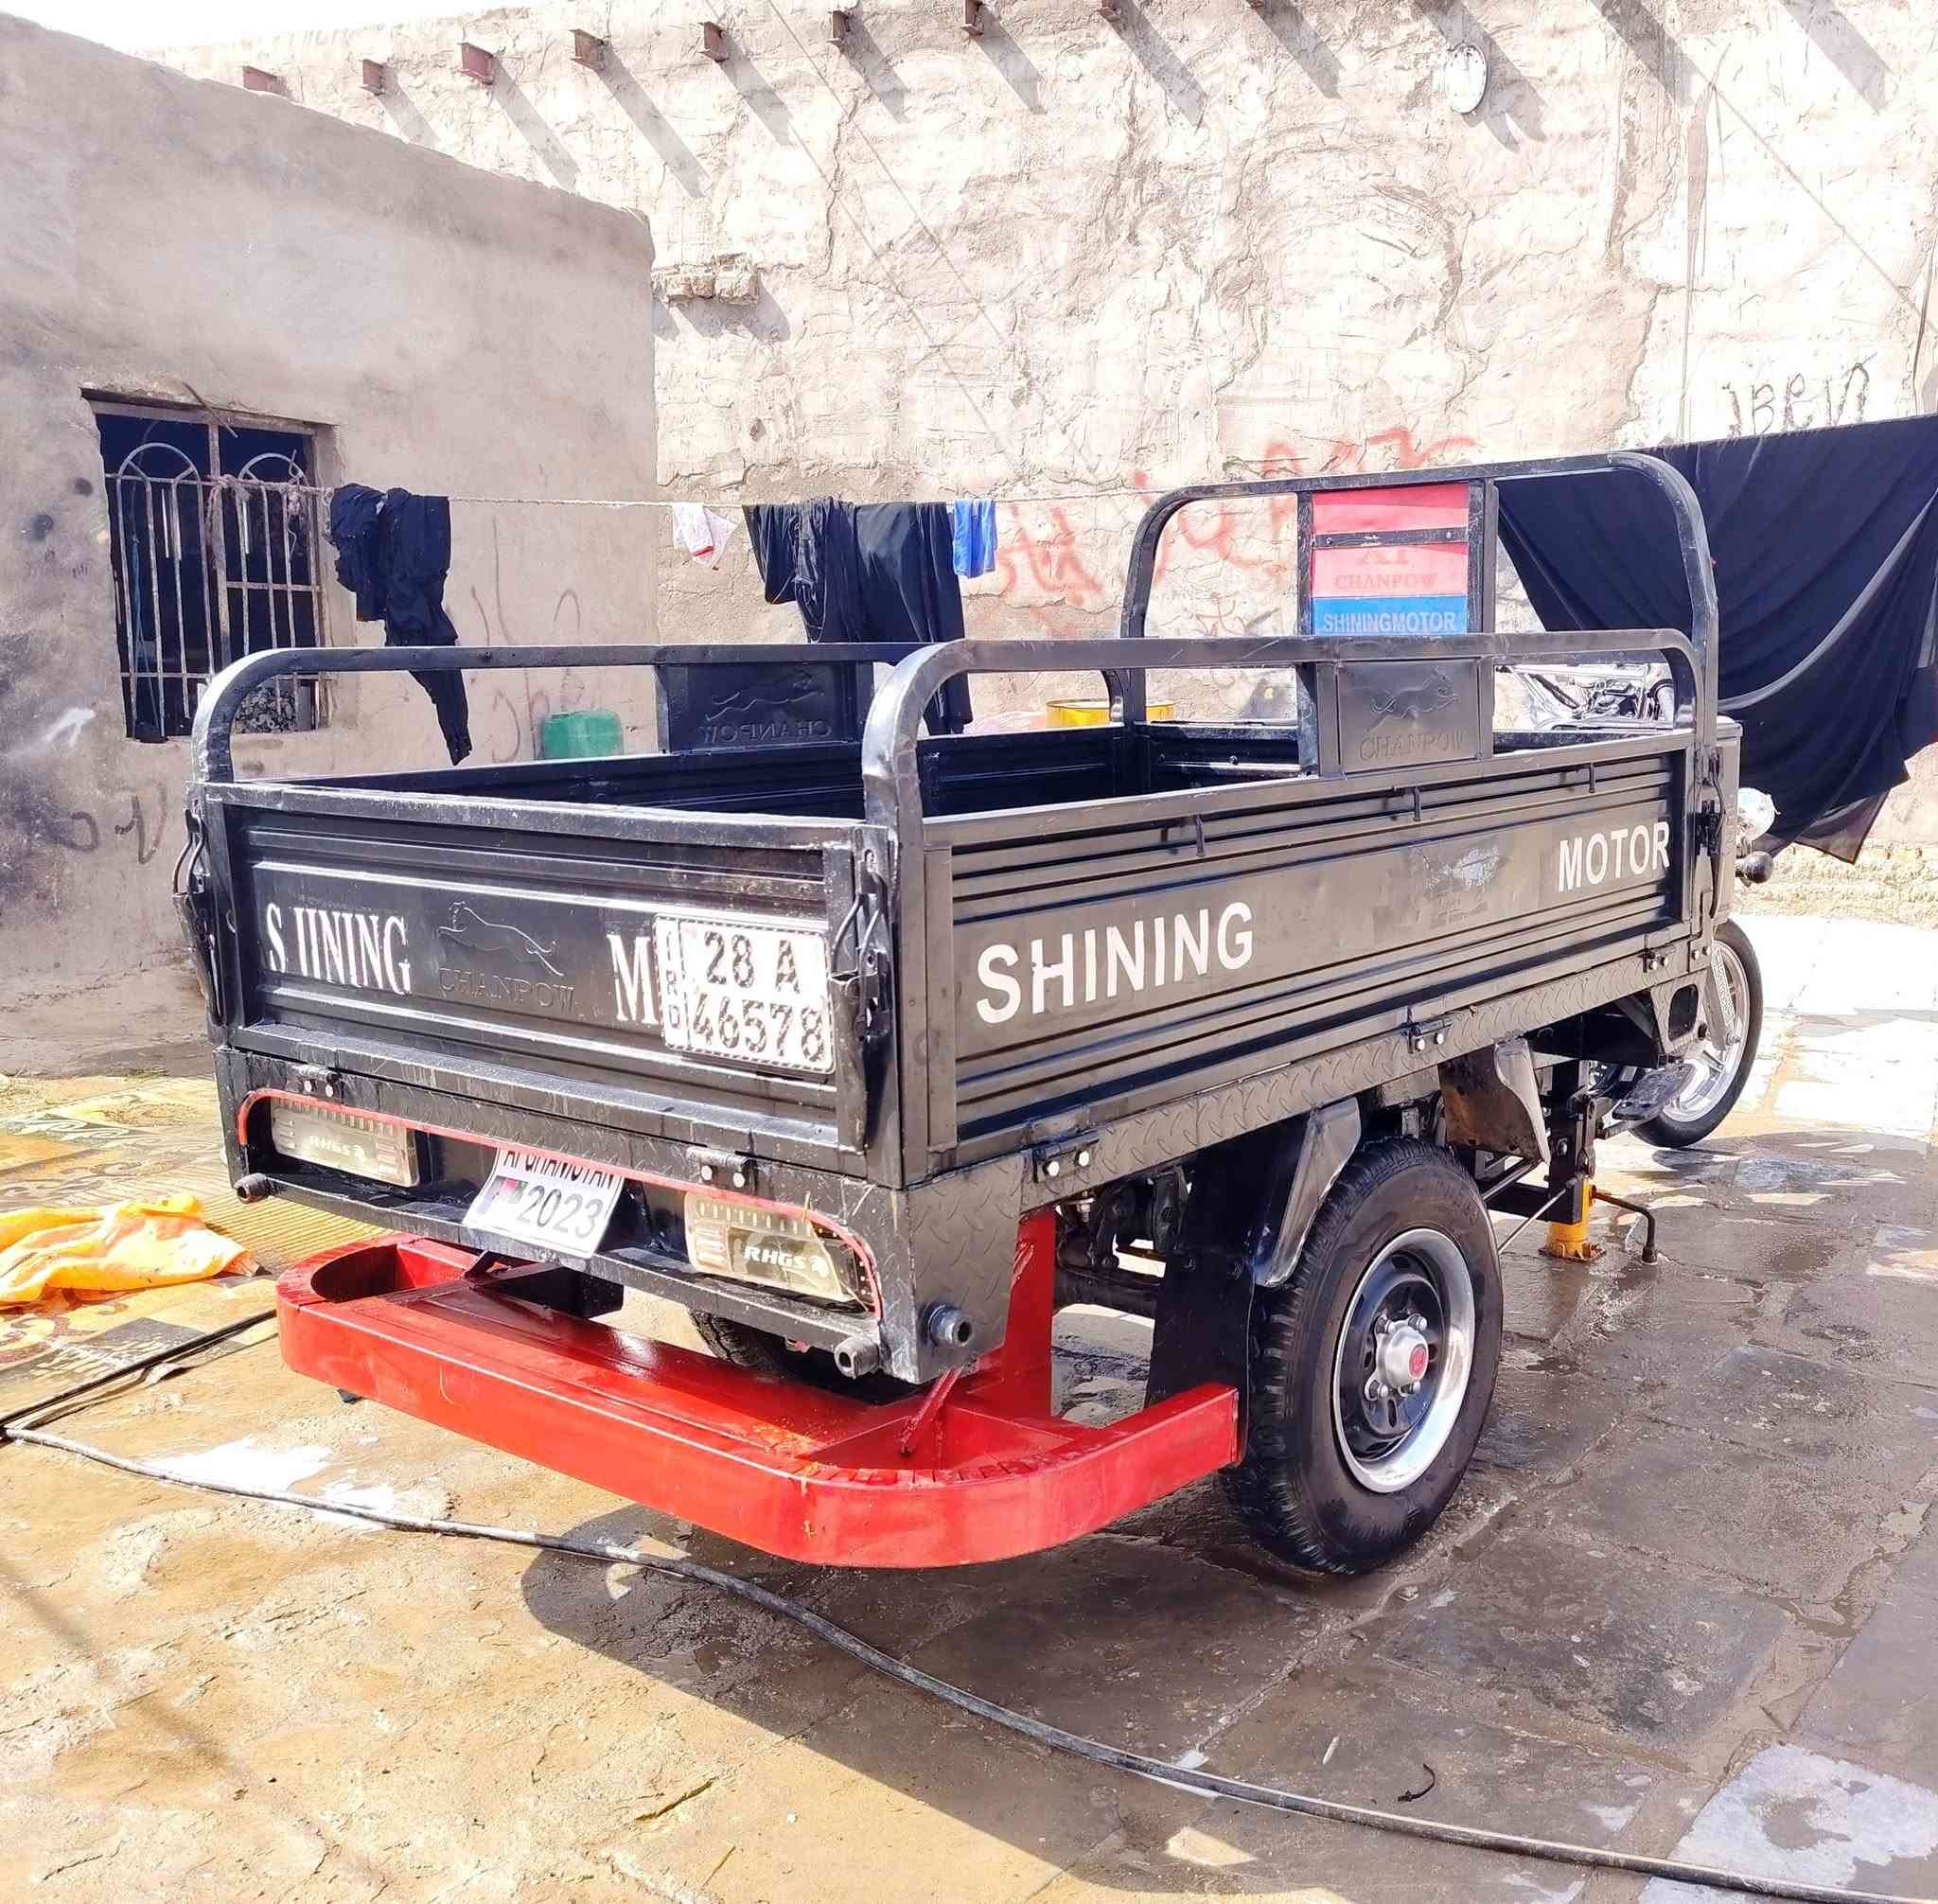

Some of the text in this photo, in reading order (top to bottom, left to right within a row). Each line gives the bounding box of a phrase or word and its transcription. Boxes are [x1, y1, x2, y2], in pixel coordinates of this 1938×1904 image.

[1334, 572, 1438, 591] CHANPOW
[1324, 610, 1457, 634] SHININGMOTOR
[976, 820, 1670, 1023] SHINING MOTOR
[703, 930, 801, 994] 28 A
[693, 993, 824, 1063] 46578
[516, 1185, 604, 1239] 2023
[742, 1244, 807, 1271] RHGS
